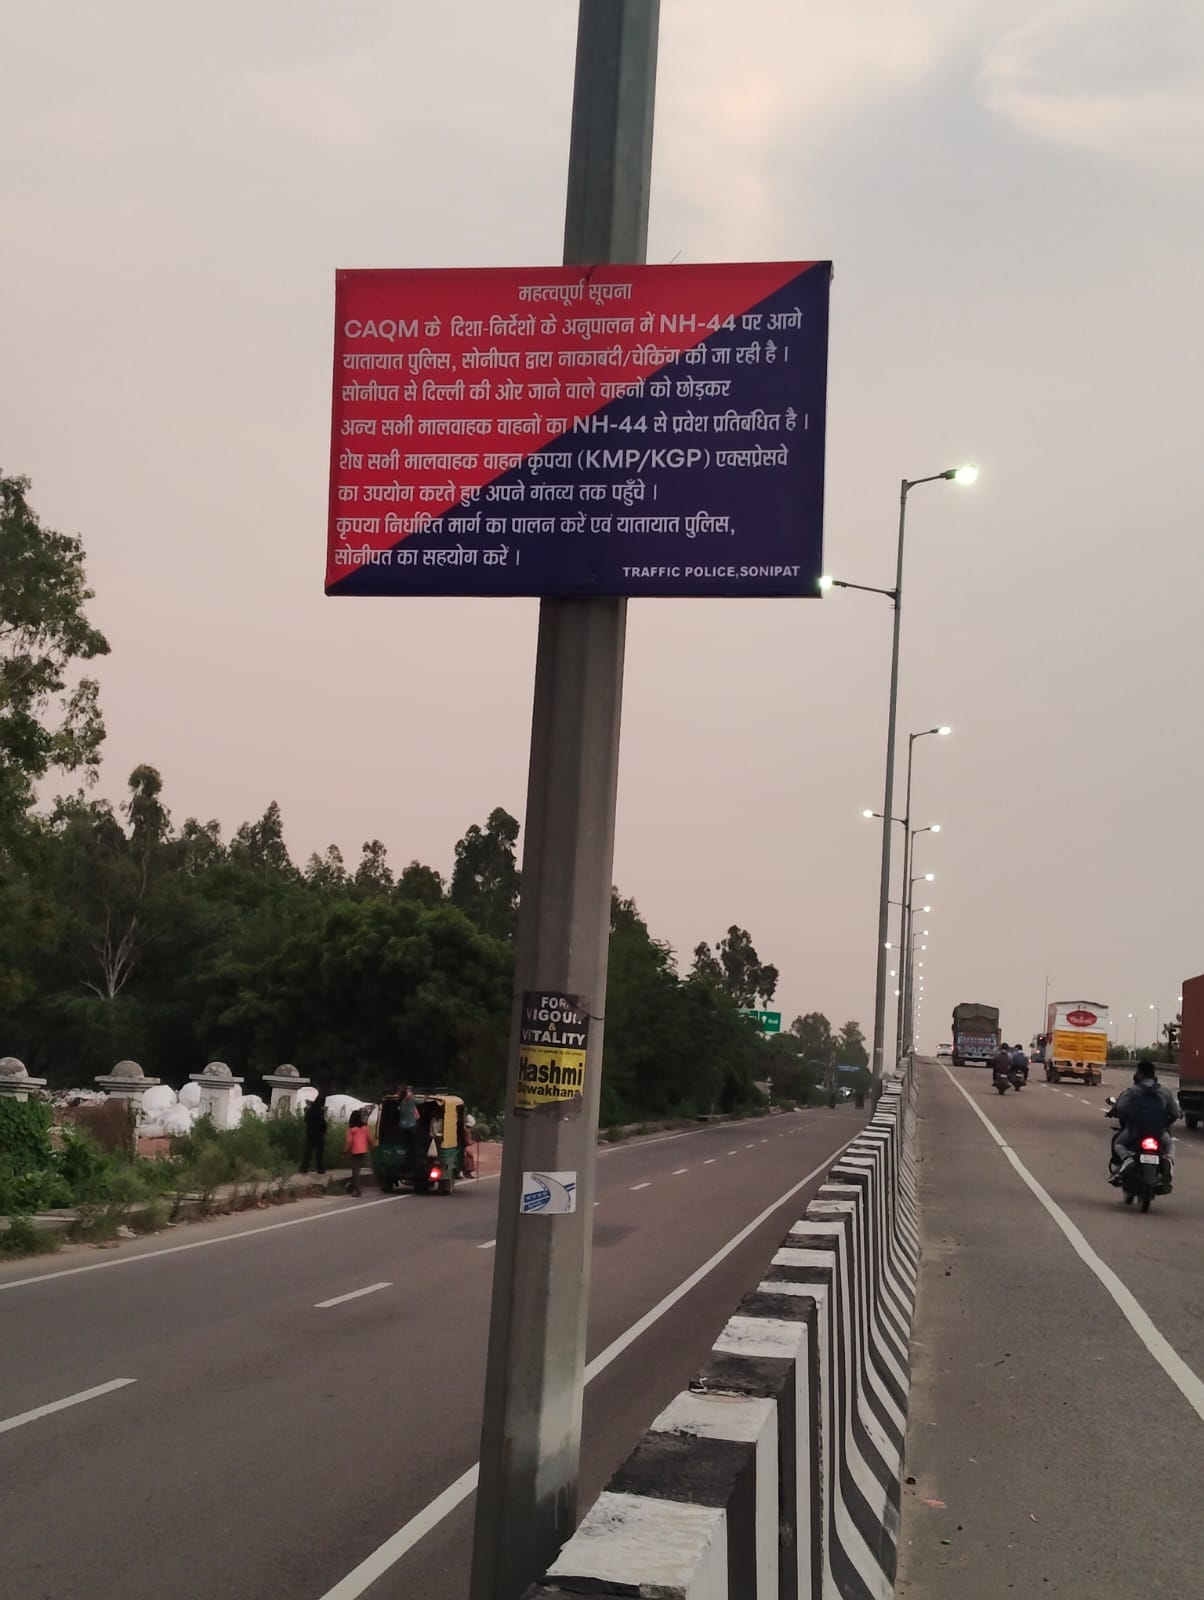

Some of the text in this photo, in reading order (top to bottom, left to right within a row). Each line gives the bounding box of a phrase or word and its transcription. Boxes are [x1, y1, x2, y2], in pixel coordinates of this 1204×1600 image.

[518, 278, 632, 306] महत्वपूर्ण सूचना
[345, 307, 803, 342] CAQM के दिशा-निर्देशों के अनुपालन में NH-44 पर आगे
[344, 354, 404, 369] यातायात
[408, 348, 456, 375] पुलिस,
[462, 347, 520, 368] सोनीपत
[525, 352, 553, 369] द्वारा
[558, 344, 680, 367] नाकाबंदी/चेकिंग
[685, 343, 707, 364] की
[711, 348, 731, 364] जा
[736, 341, 761, 364] रही
[765, 340, 777, 363] है
[343, 375, 731, 401] सोनीपत से दिल्ली की ओर जाने वाले वाहनों को छोड़कर
[341, 420, 376, 435] अन्य
[381, 414, 414, 435] सभी
[418, 419, 493, 435] मालवाहक
[497, 412, 542, 435] वाहनों
[546, 418, 568, 434] का
[574, 415, 648, 433] NH-44
[654, 410, 668, 432] से
[673, 410, 709, 434] प्रवेश
[713, 409, 781, 432] प्रतिबंधित
[785, 407, 797, 431] है
[340, 443, 789, 474] शेष सभी मालवाहक वाहन कृपया (KMP/KGP) एक्सप्रेसवे
[339, 486, 359, 501] का
[363, 480, 415, 501] उपयोग
[419, 480, 456, 501] करते
[460, 485, 482, 507] हुए
[486, 480, 525, 501] अपने
[530, 482, 574, 501] गंतव्य
[579, 485, 607, 501] तक
[612, 478, 645, 506] पहुँचे
[337, 511, 735, 539] कृपया निर्धारित मार्ग का पालन करें एवं यातायात पुलिस,
[336, 544, 393, 565] सोनीपत
[397, 550, 418, 565] का
[423, 544, 478, 566] सहयोग
[483, 544, 509, 565] करें
[622, 566, 800, 579] TRAFFIC POLICE,SONIPAT
[522, 1029, 586, 1046] VITALITY
[548, 1023, 557, 1031] &
[518, 1056, 583, 1086] Hashmi
